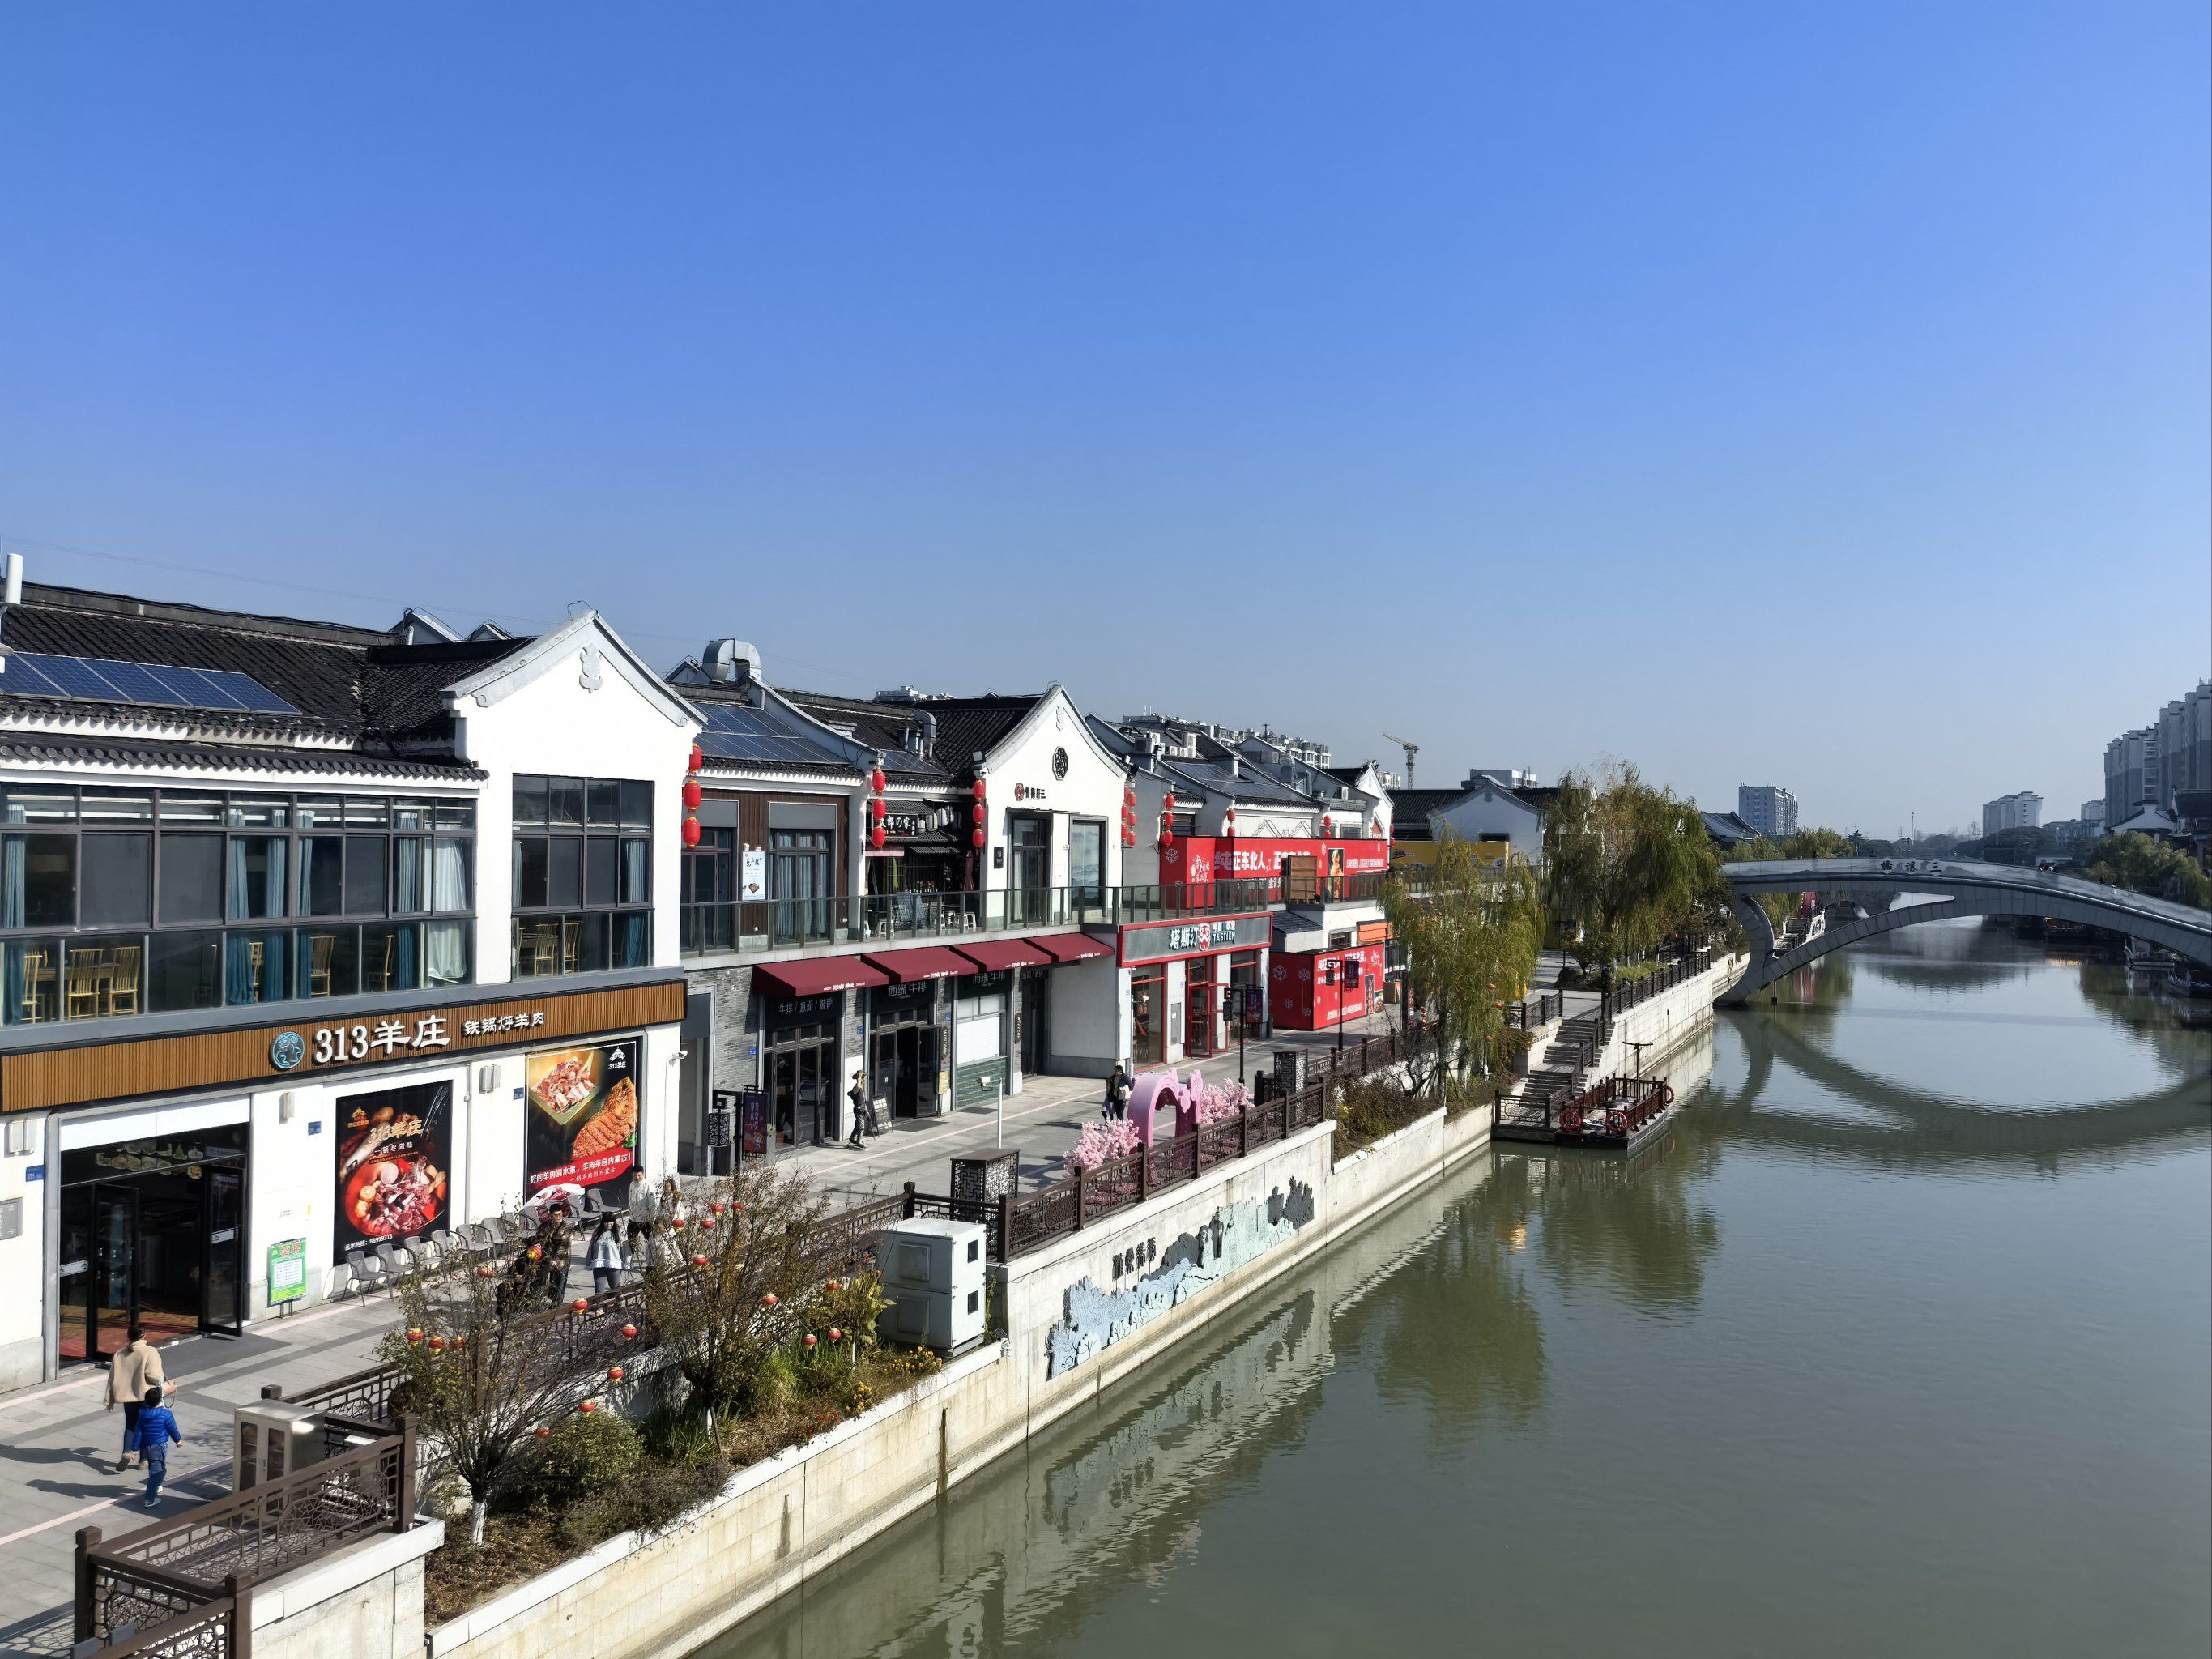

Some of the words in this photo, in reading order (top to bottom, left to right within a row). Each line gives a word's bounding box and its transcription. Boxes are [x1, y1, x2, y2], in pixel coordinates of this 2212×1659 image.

[1170, 927, 1199, 949] 塔斯汀
[315, 1015, 451, 1064] 313羊庄
[368, 1118, 424, 1144] 313羊庄
